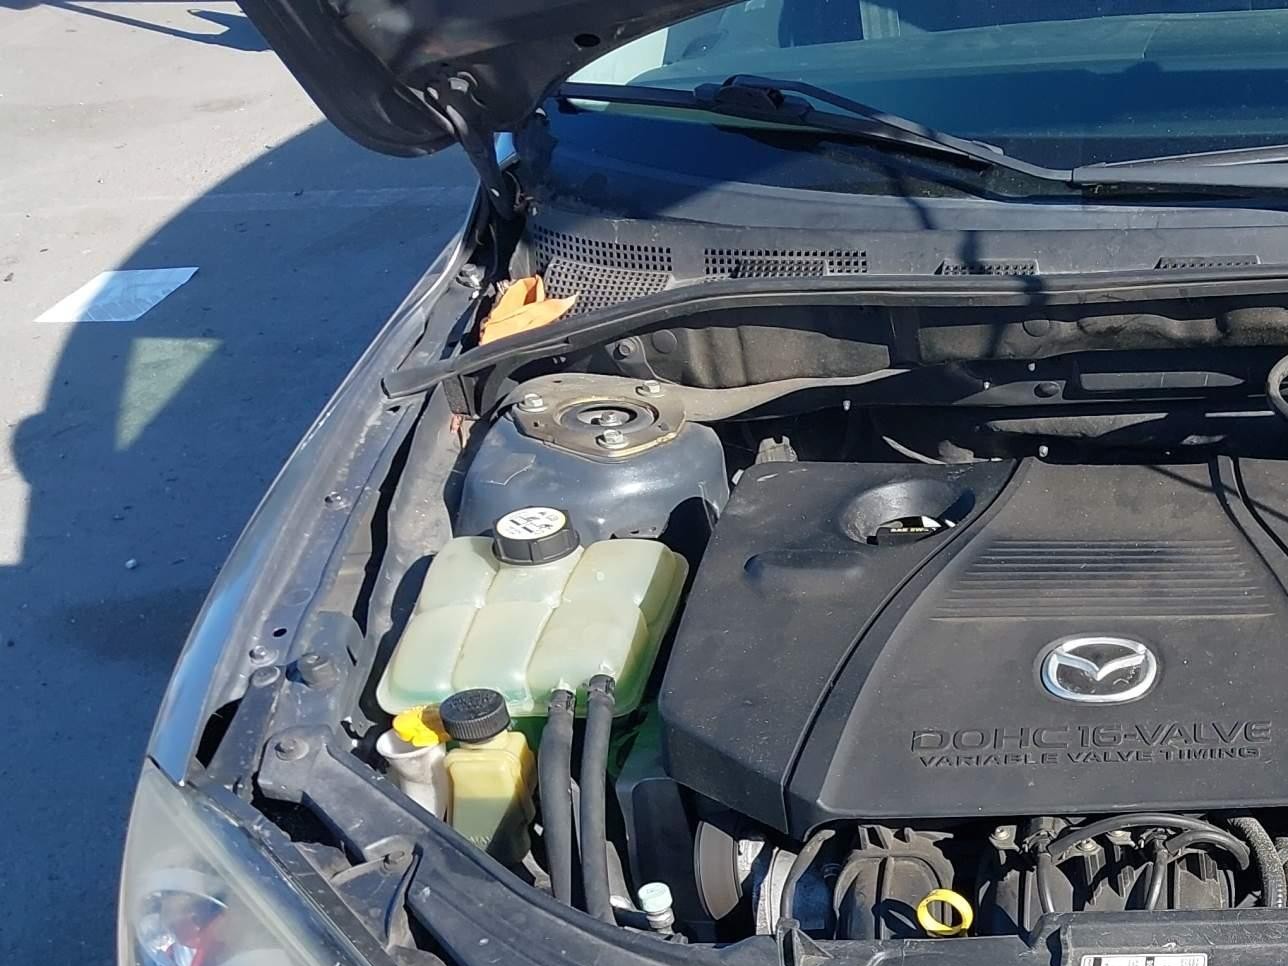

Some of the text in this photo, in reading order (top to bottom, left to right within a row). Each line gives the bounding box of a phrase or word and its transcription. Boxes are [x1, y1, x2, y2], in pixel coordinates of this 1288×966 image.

[911, 720, 1273, 752] DOHC 16-VALVE
[918, 747, 1262, 767] VARIABLE VALVE TIMING
